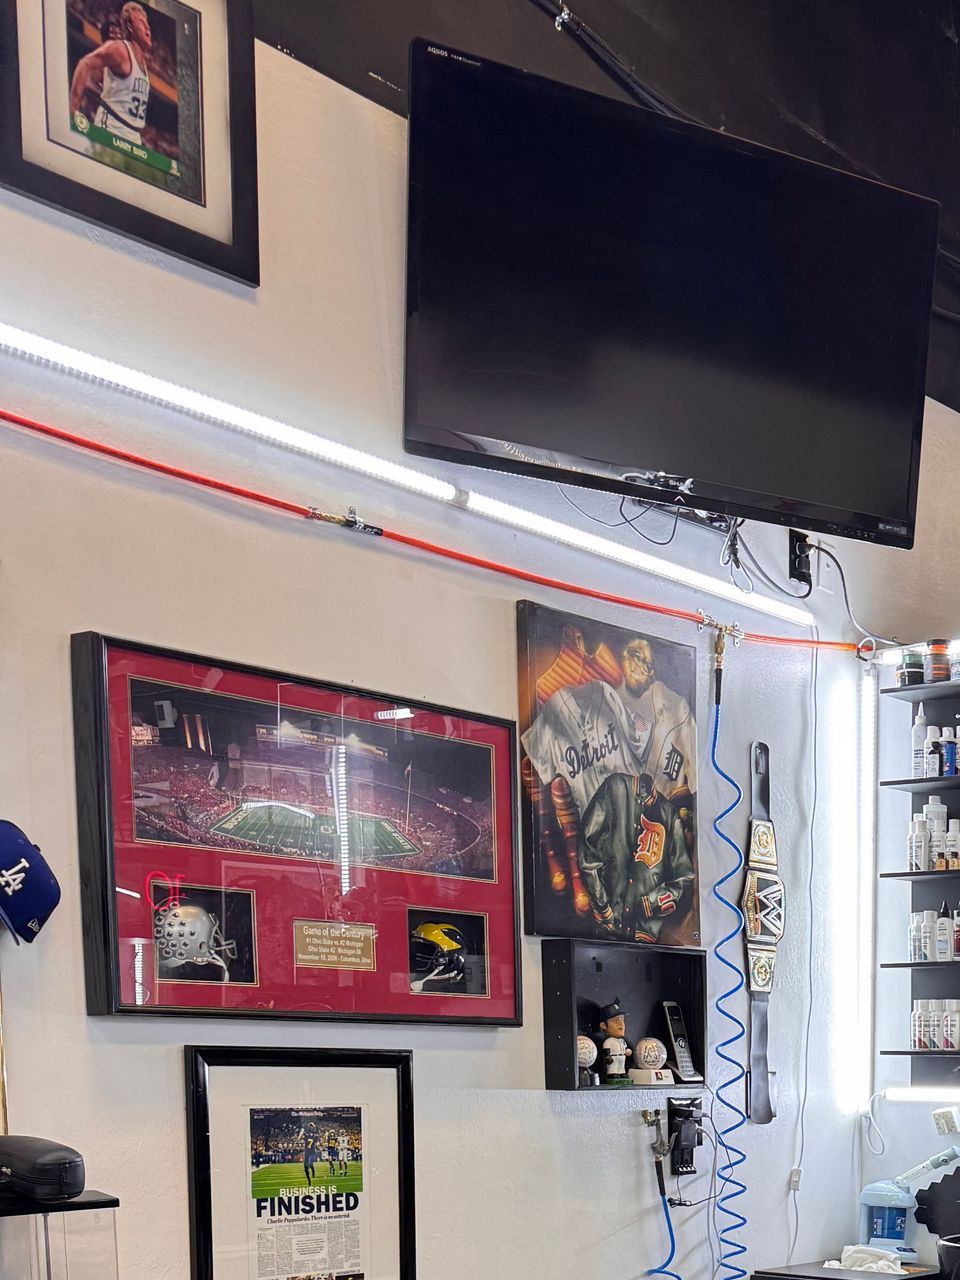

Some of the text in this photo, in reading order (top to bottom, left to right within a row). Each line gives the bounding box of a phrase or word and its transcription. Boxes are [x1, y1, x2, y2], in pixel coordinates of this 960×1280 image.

[427, 46, 449, 57] AQUOS
[113, 137, 148, 159] LARRY BIRD
[565, 722, 619, 779] Detroit
[303, 926, 364, 940] Game of the Century
[280, 1185, 337, 1198] BUSINESS IS
[256, 1192, 359, 1217] FINISHED
